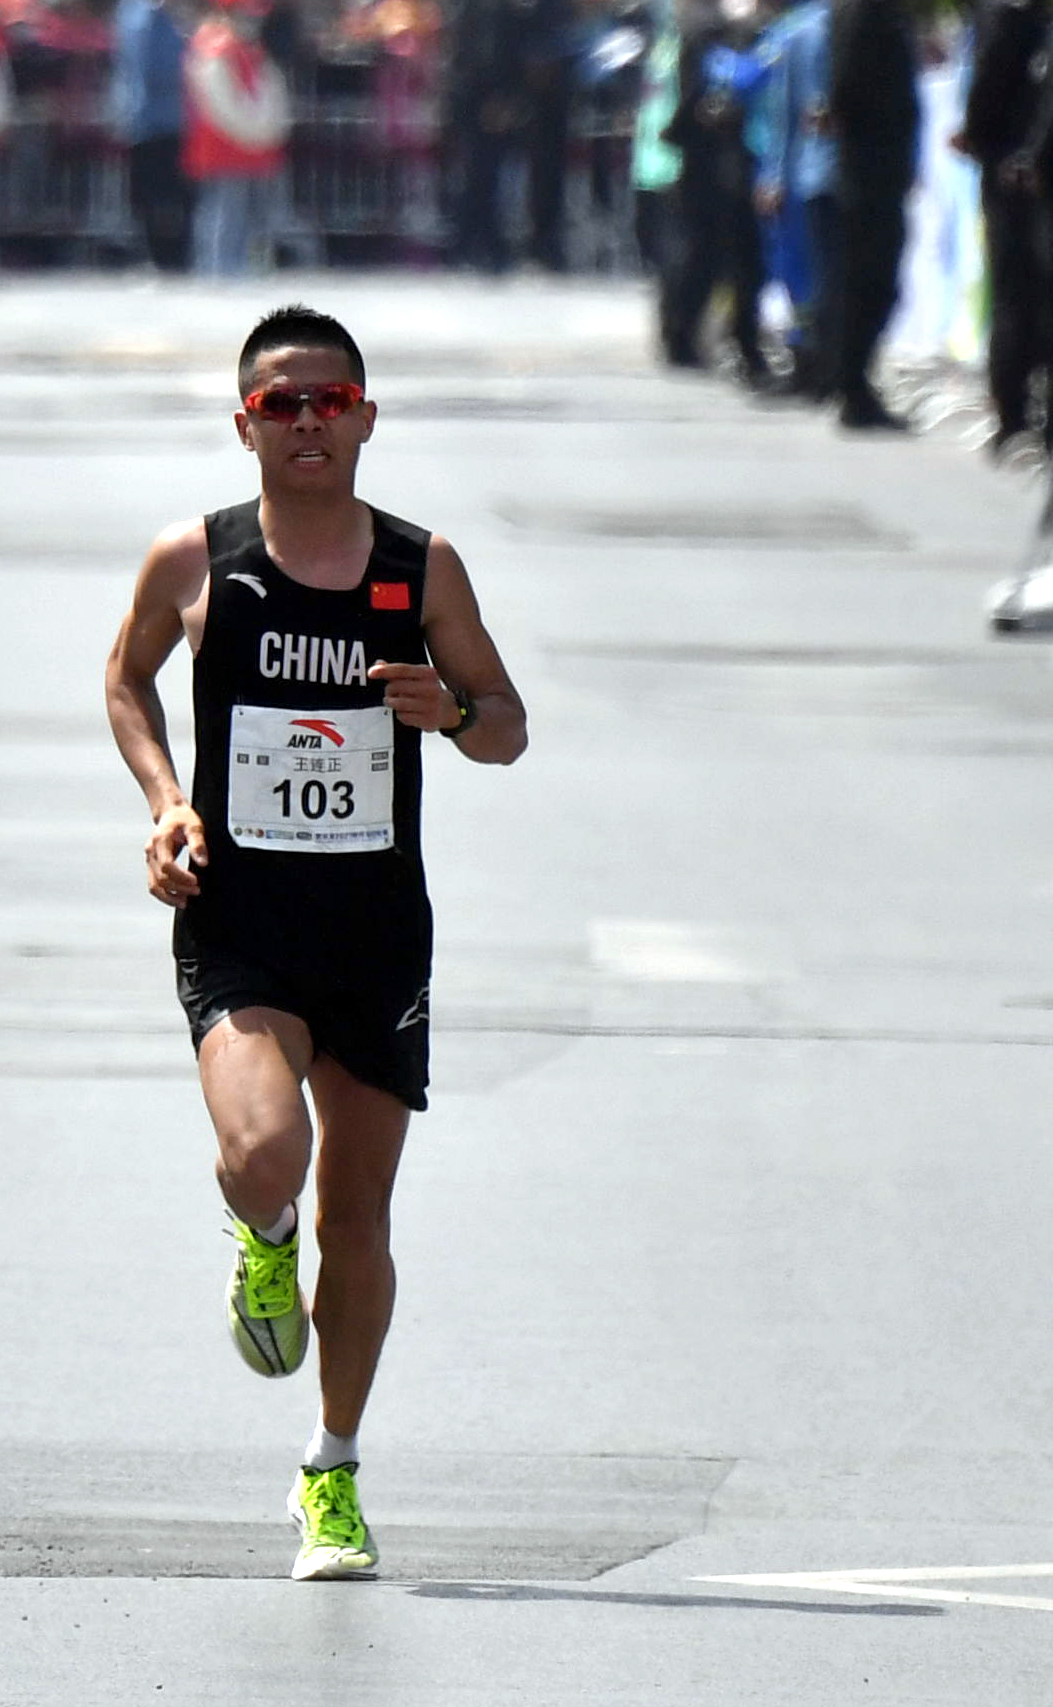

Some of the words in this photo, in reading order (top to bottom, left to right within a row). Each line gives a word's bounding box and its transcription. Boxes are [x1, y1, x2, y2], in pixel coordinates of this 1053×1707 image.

[259, 631, 367, 687] CHINA
[287, 734, 323, 749] ANTA
[272, 779, 355, 819] 103
